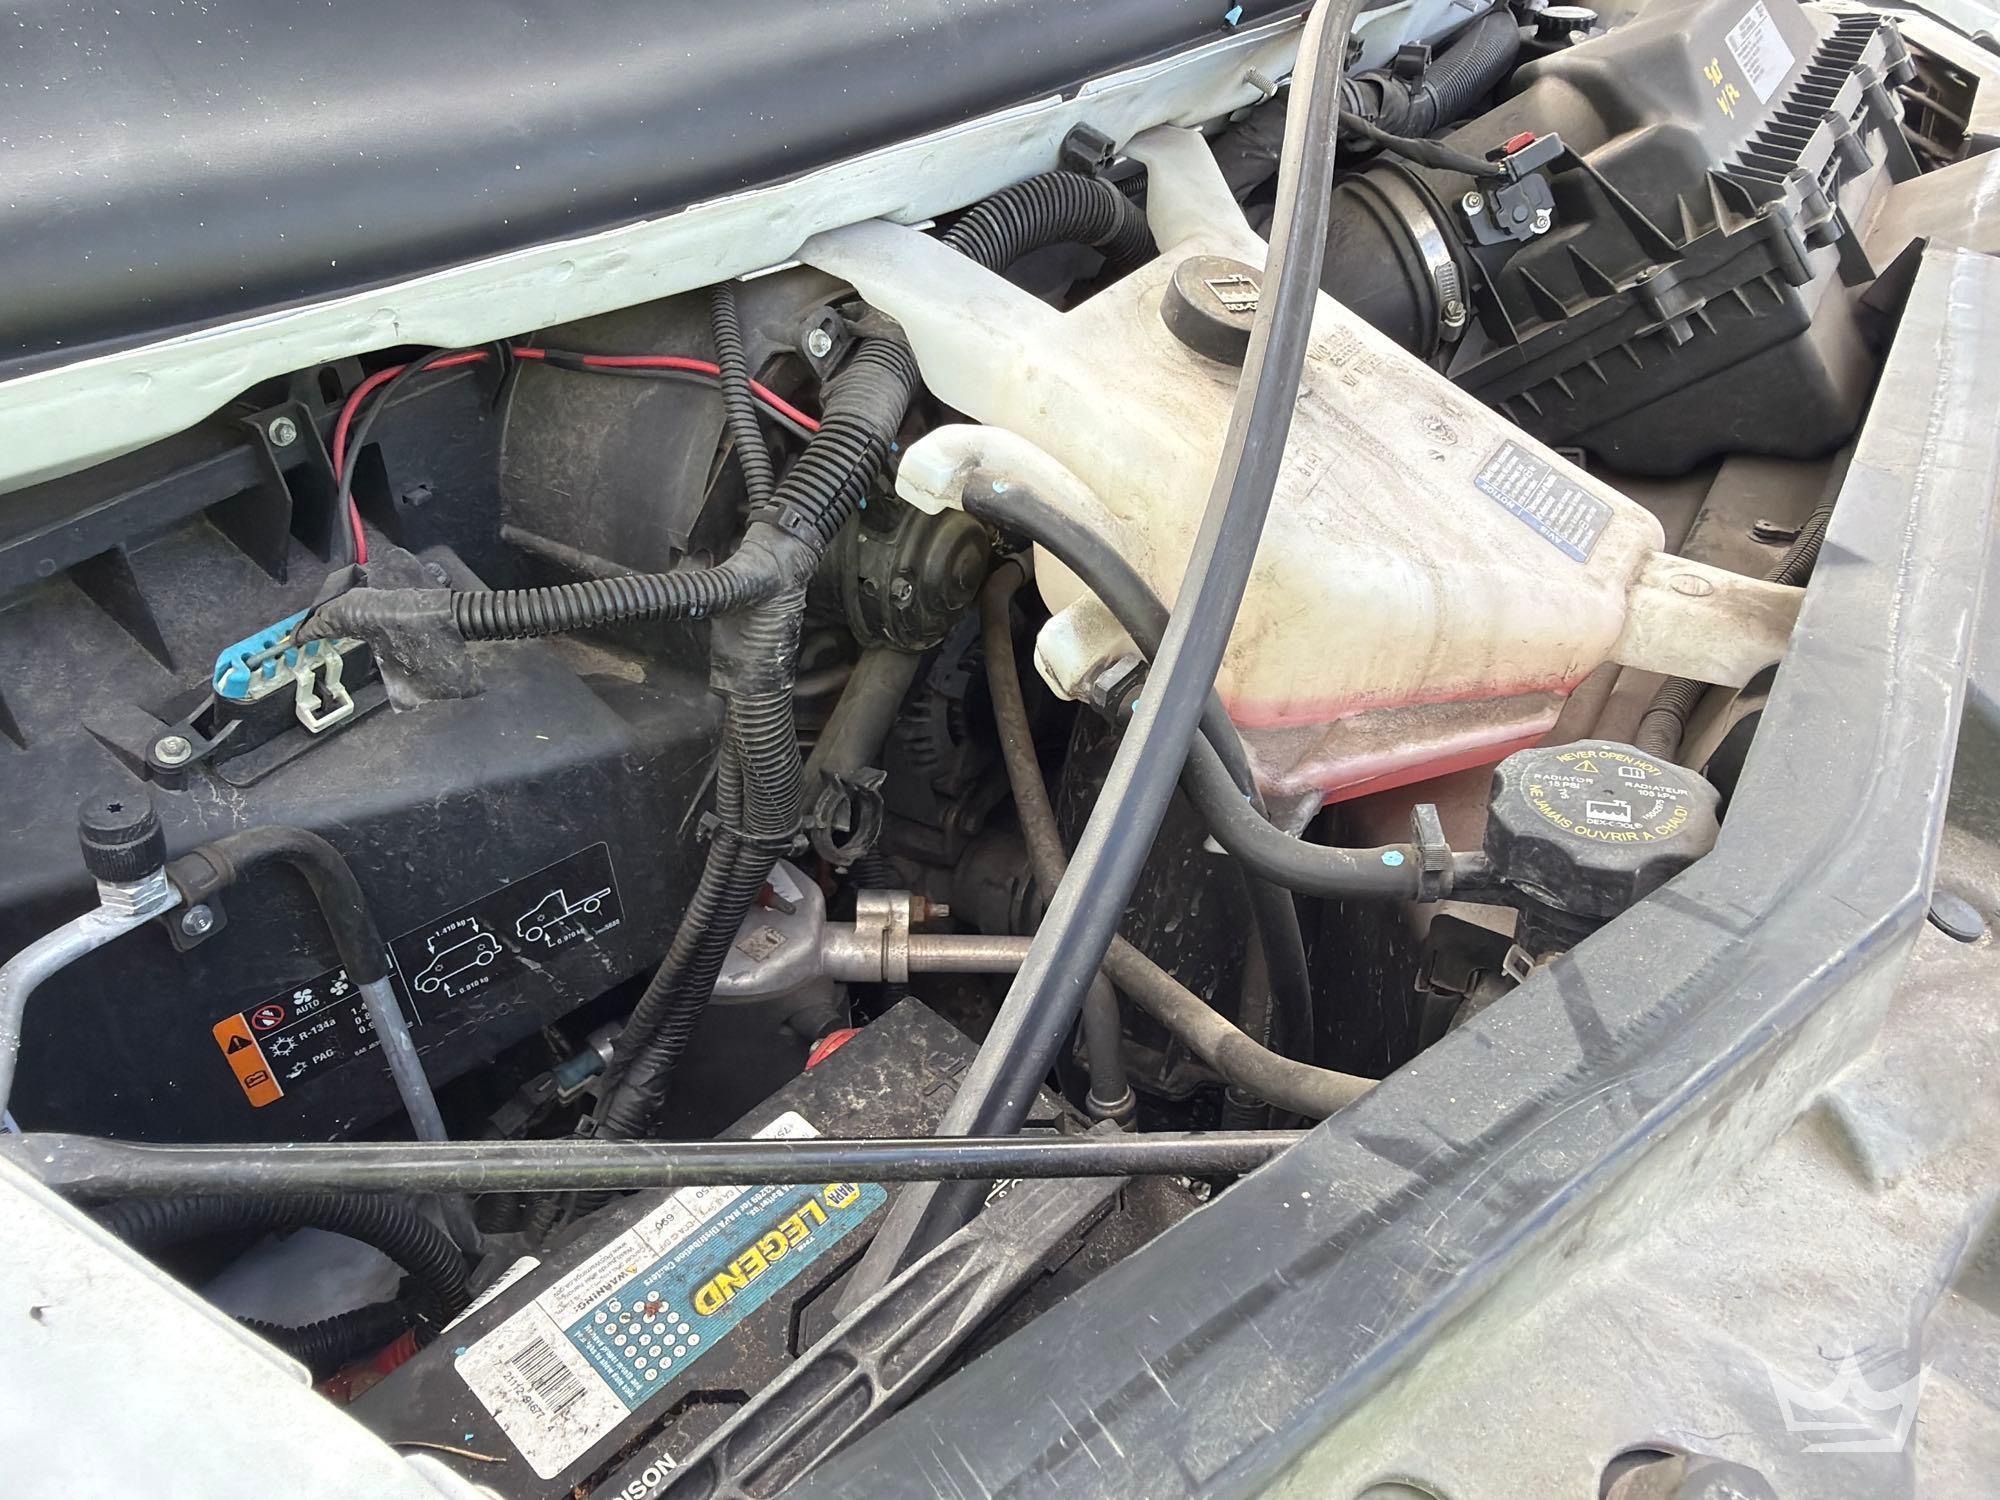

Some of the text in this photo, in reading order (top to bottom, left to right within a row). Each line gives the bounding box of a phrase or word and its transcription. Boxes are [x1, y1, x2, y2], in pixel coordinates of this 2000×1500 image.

[1556, 750, 1662, 775] NEVER OPEN HOT!
[1534, 774, 1593, 784] RADIATOR
[1624, 781, 1688, 795] RADIATEUR
[1529, 784, 1543, 797] NE
[1657, 792, 1676, 800] kPa
[1534, 799, 1571, 828] JAMAIS
[1574, 825, 1639, 840] OUVRIR
[1642, 831, 1655, 840] A
[294, 998, 321, 1015] AUTO
[297, 1003, 368, 1040] R-134a 1.4
[311, 1048, 335, 1064] PAG
[825, 1183, 854, 1206] NAPA
[738, 1199, 752, 1212] for
[653, 1211, 675, 1230] 690
[716, 1208, 741, 1229] NAPA
[672, 1225, 720, 1264] Distribution
[689, 1199, 831, 1318] LEGEND
[572, 1269, 628, 1314] WARNING:
[630, 1377, 642, 1390] and
[613, 1452, 677, 1500] ISON
